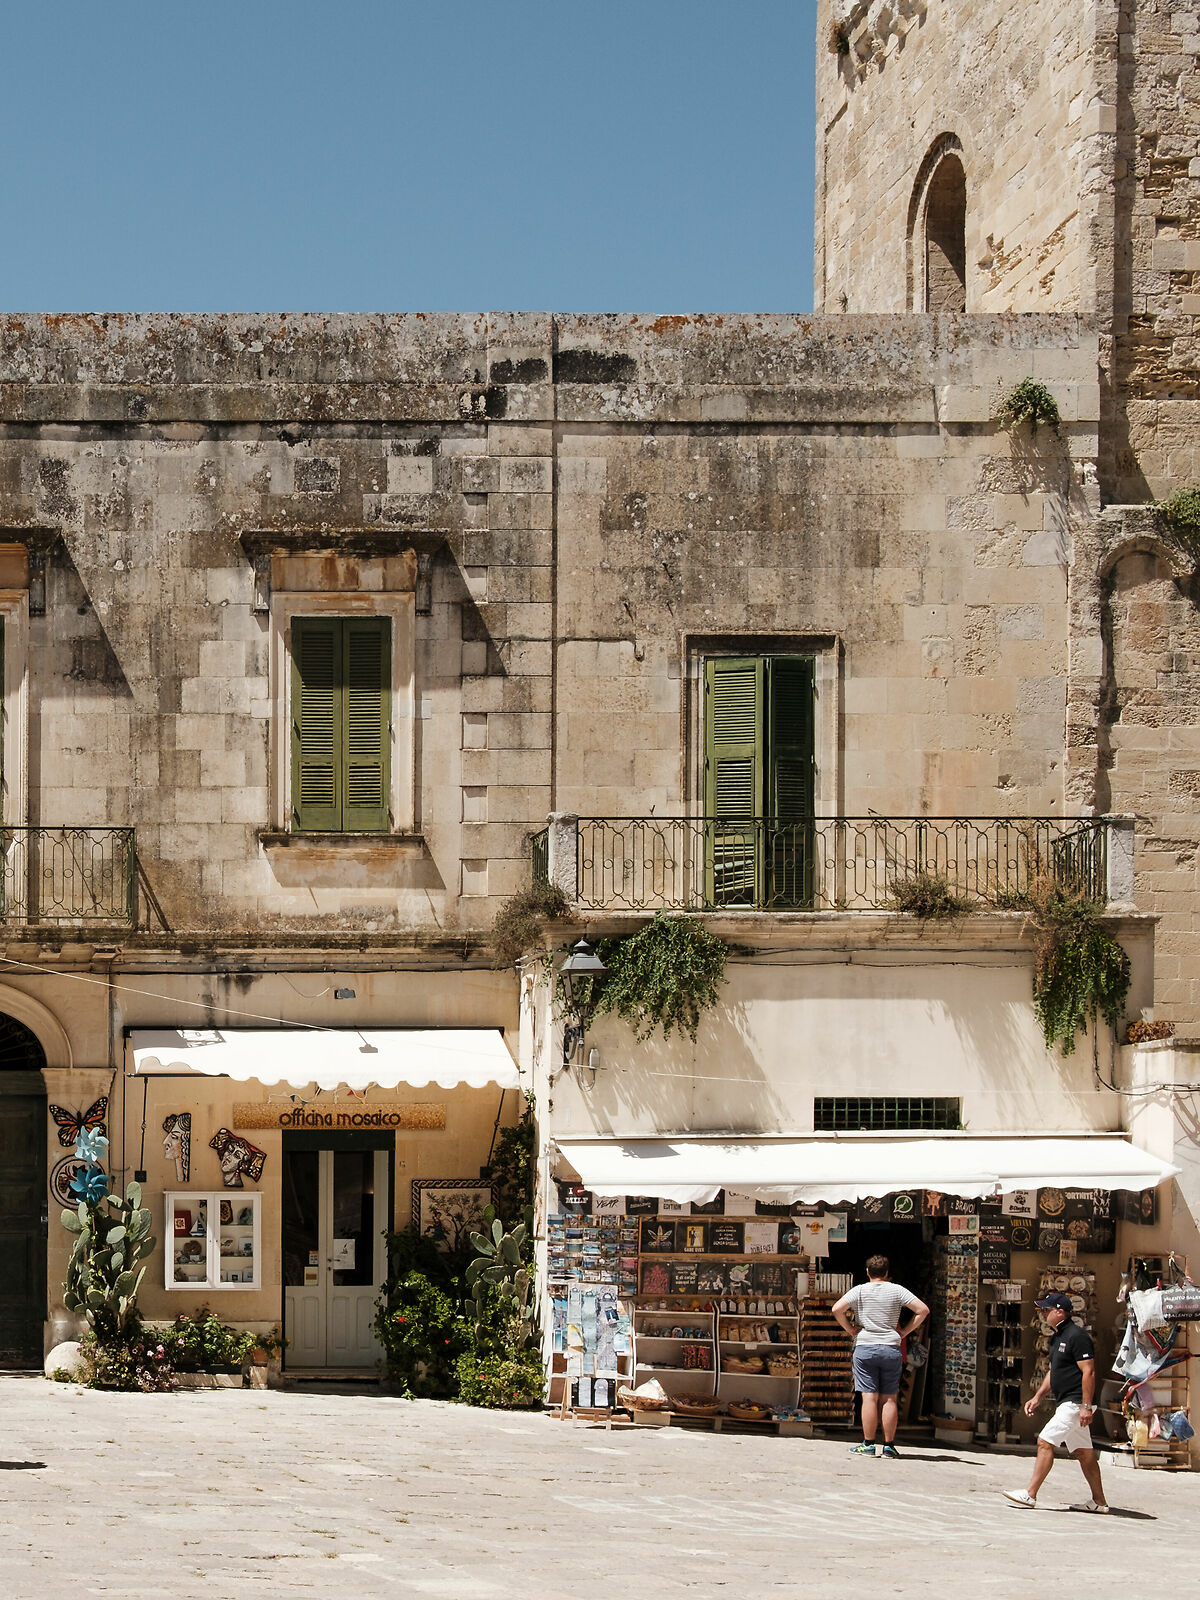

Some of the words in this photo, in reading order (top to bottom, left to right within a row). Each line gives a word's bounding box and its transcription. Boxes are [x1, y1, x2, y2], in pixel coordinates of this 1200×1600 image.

[279, 1108, 333, 1127] officina
[337, 1109, 401, 1127] mosaico
[1010, 1218, 1032, 1227] NIRVANA
